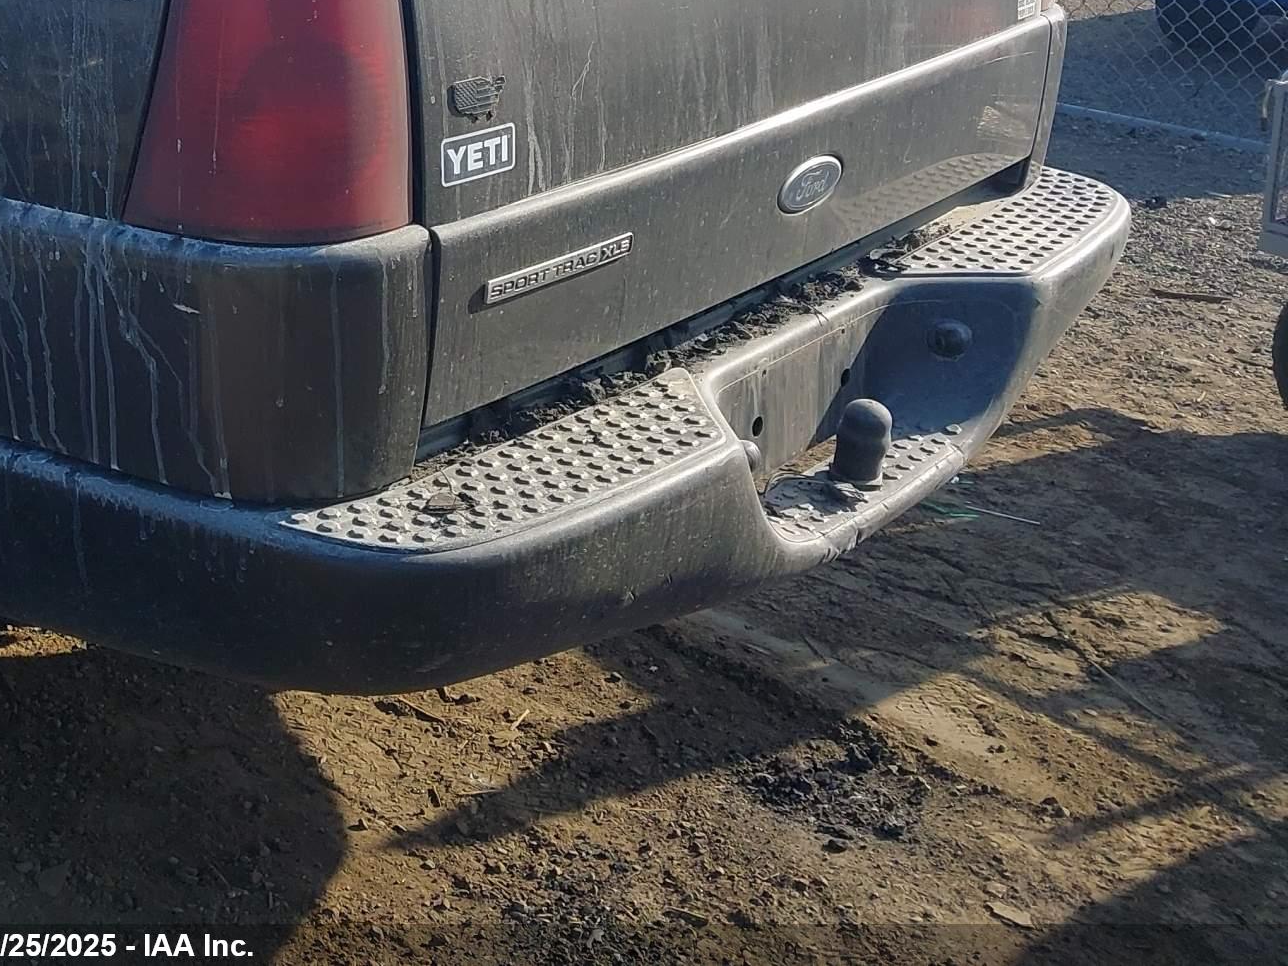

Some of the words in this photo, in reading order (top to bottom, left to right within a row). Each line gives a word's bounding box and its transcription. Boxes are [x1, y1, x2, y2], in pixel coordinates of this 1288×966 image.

[446, 134, 508, 175] YETI
[490, 268, 550, 299] SPORT
[552, 251, 599, 278] TRAC
